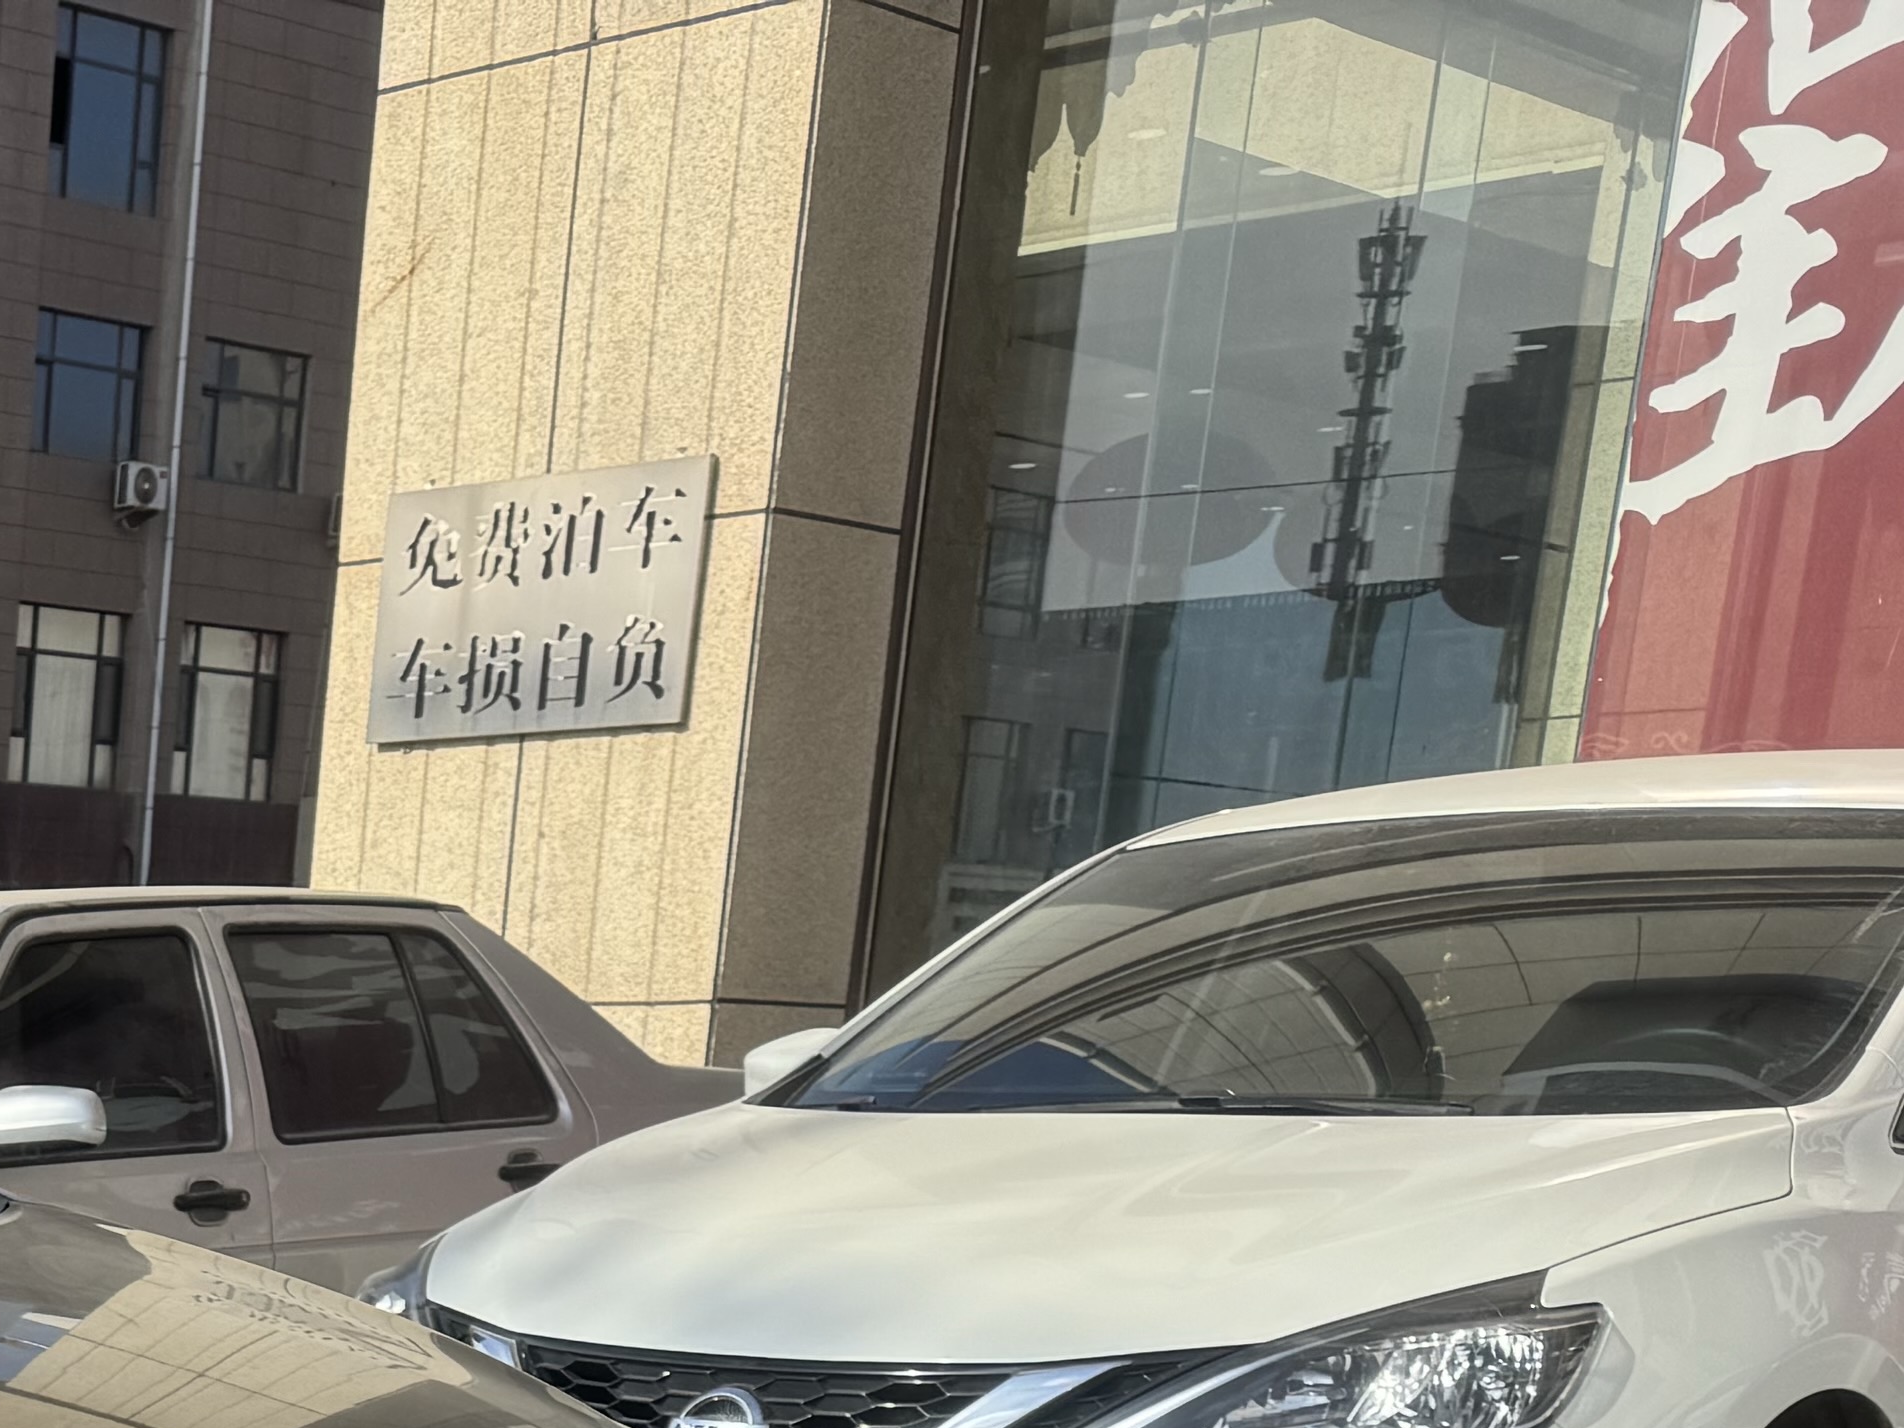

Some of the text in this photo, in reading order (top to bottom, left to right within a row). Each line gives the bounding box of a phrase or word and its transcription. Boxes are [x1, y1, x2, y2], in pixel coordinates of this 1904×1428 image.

[404, 483, 688, 598] 免费泊车
[387, 615, 669, 720] 车损自负
